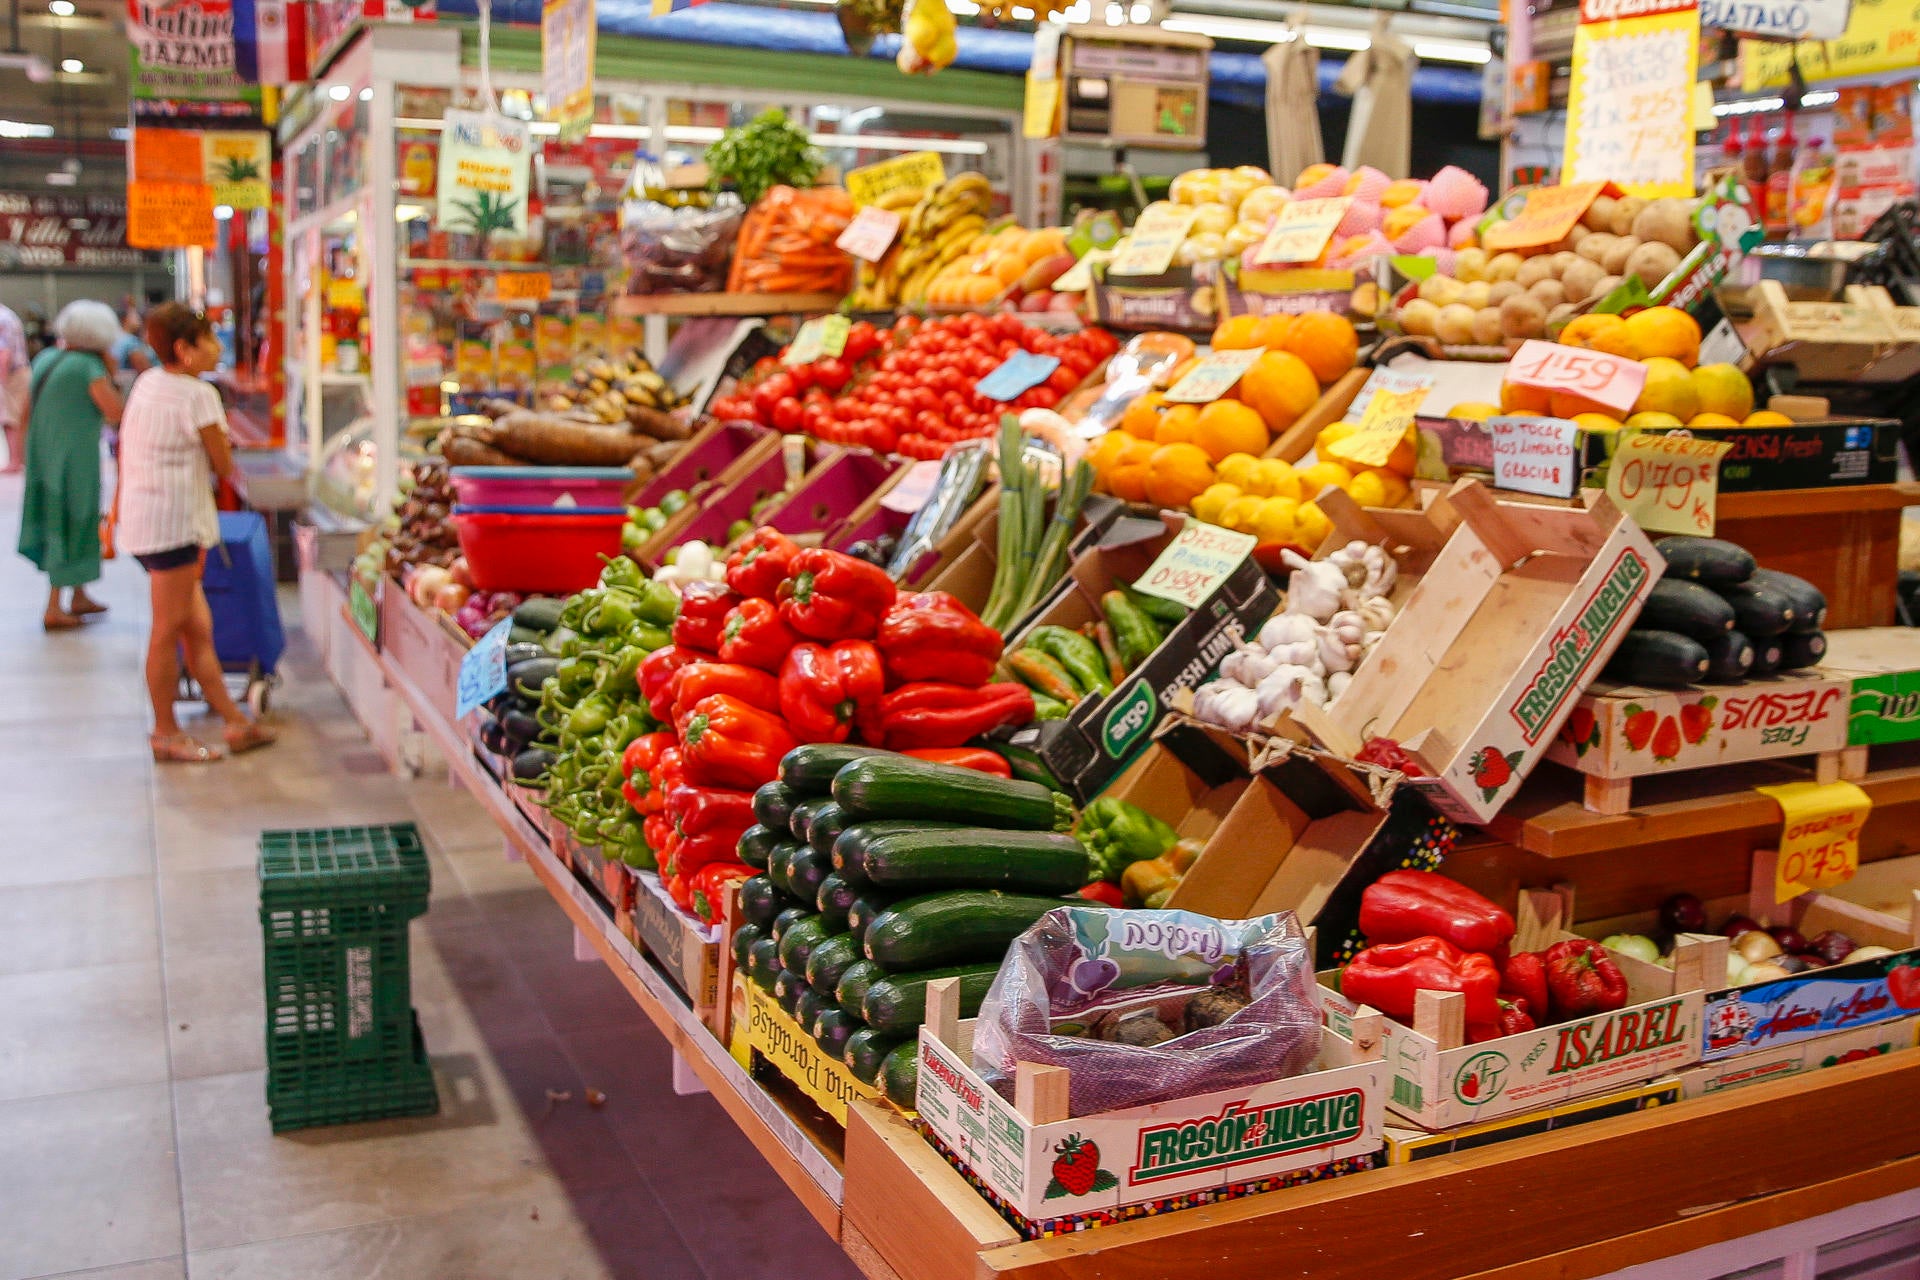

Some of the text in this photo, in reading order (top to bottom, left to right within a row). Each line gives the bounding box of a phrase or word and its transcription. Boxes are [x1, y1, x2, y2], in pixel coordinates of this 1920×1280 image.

[1619, 458, 1695, 512] 0'79
[1109, 699, 1149, 741] argo
[1721, 687, 1842, 731] JESUS
[752, 1003, 821, 1090] Paradise
[1548, 1000, 1686, 1076] ISABEL
